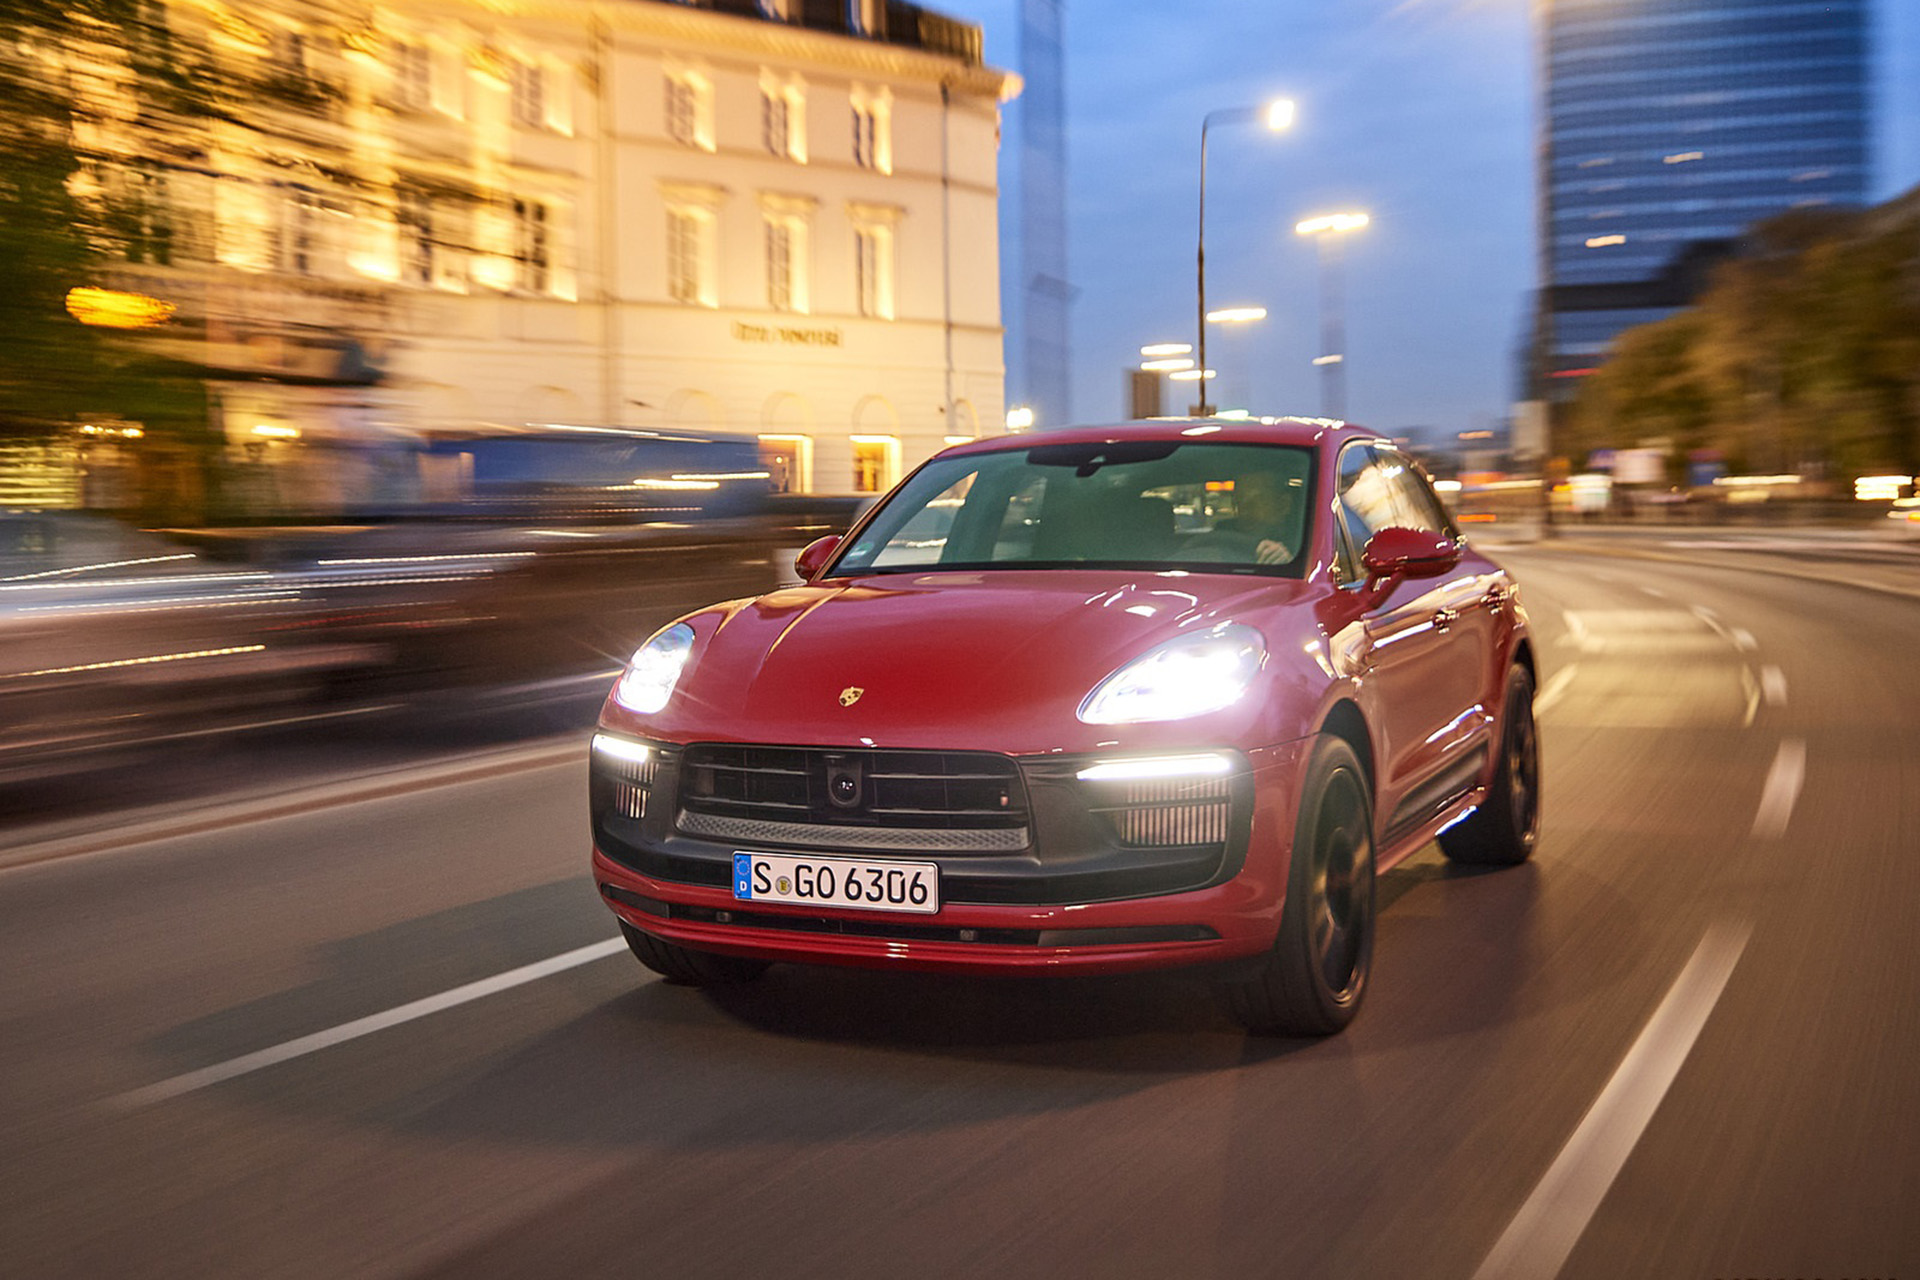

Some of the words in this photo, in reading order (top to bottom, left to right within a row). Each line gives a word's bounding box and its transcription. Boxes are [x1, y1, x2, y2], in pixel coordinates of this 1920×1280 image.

[739, 880, 748, 892] D
[753, 862, 772, 894] S
[795, 864, 836, 899] GO
[845, 867, 928, 905] 6306
